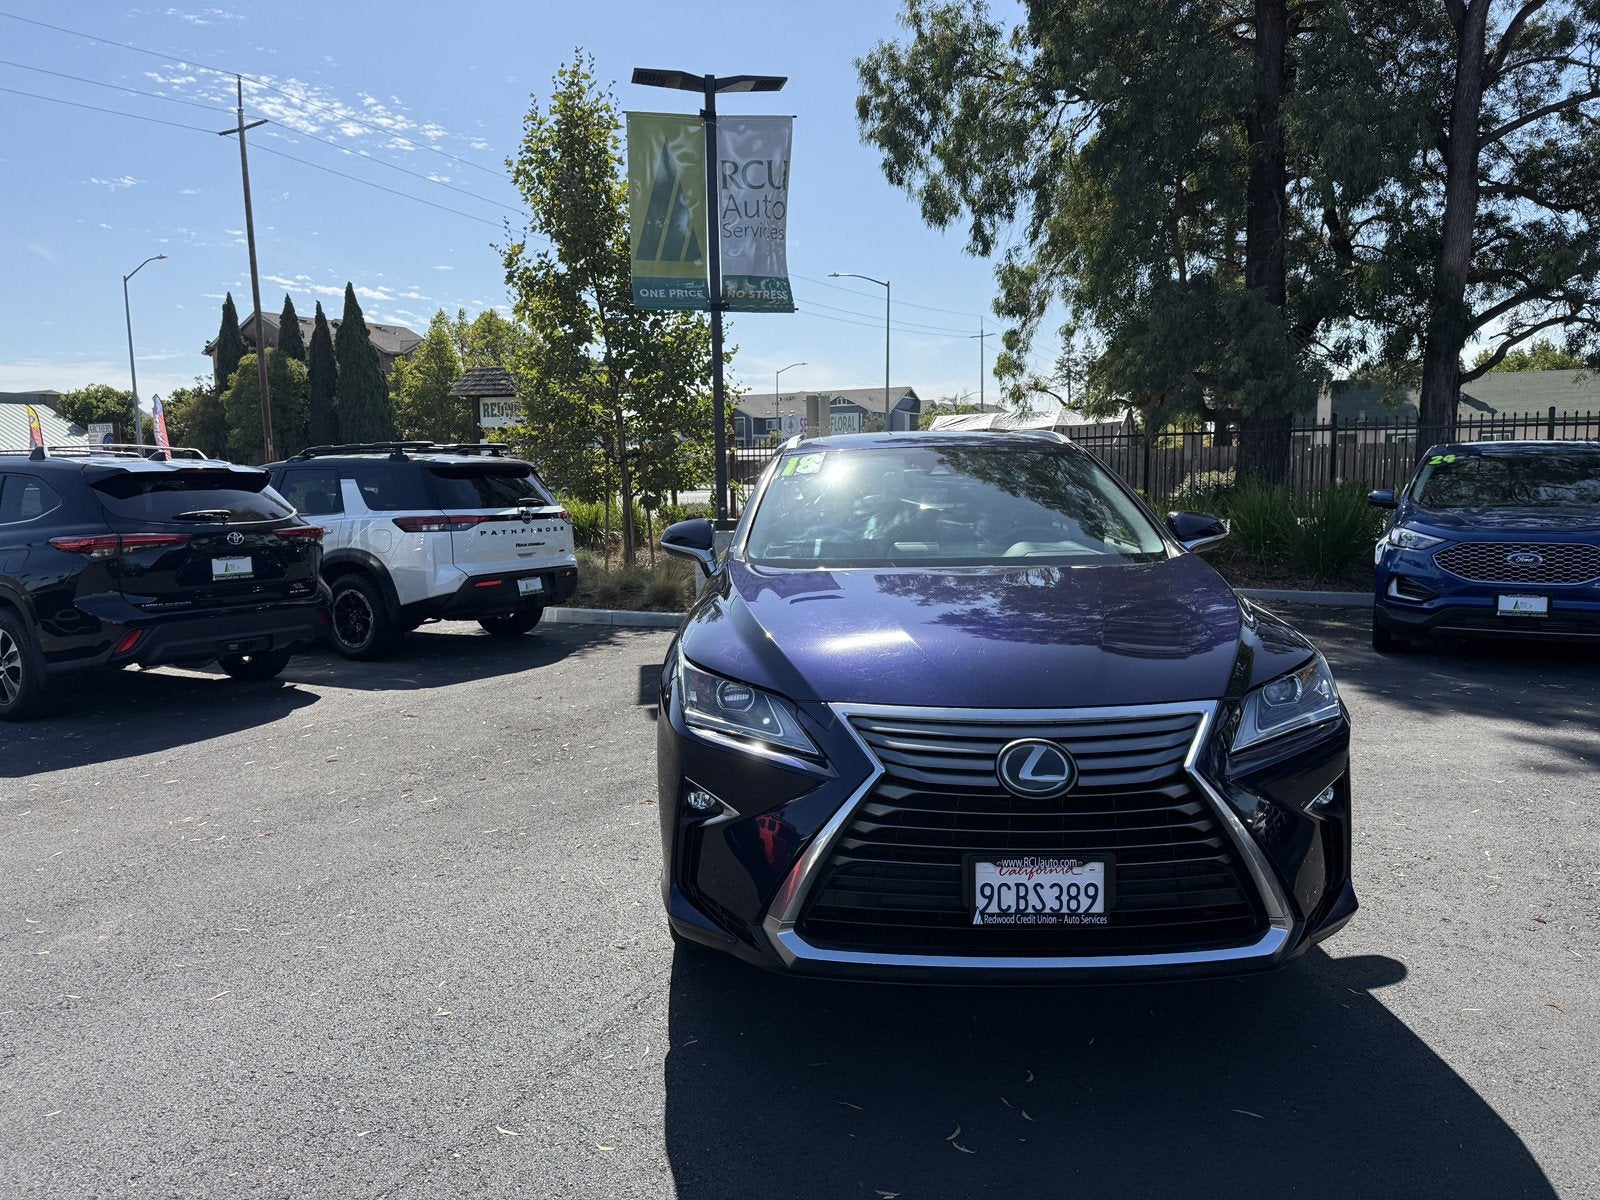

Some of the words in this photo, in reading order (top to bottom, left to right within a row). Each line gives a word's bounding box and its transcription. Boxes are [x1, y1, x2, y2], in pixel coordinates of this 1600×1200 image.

[721, 160, 788, 190] RCU
[722, 194, 785, 220] Auto
[723, 223, 784, 240] Services
[639, 288, 666, 298] ONE
[669, 289, 703, 298] PRICE
[727, 290, 745, 298] NO
[749, 290, 788, 300] STRESS
[831, 415, 856, 432] FLORAL
[1429, 454, 1456, 465] 24
[480, 526, 564, 537] PATHFINDER
[1001, 857, 1078, 868] www.RCUauto.com
[999, 866, 1083, 881] California
[979, 882, 1099, 913] 9CBS389
[984, 915, 1015, 924] Redwood
[1016, 915, 1036, 924] Credit
[1038, 915, 1058, 924] Union
[1064, 915, 1080, 924] Auto
[1081, 915, 1108, 924] Services
